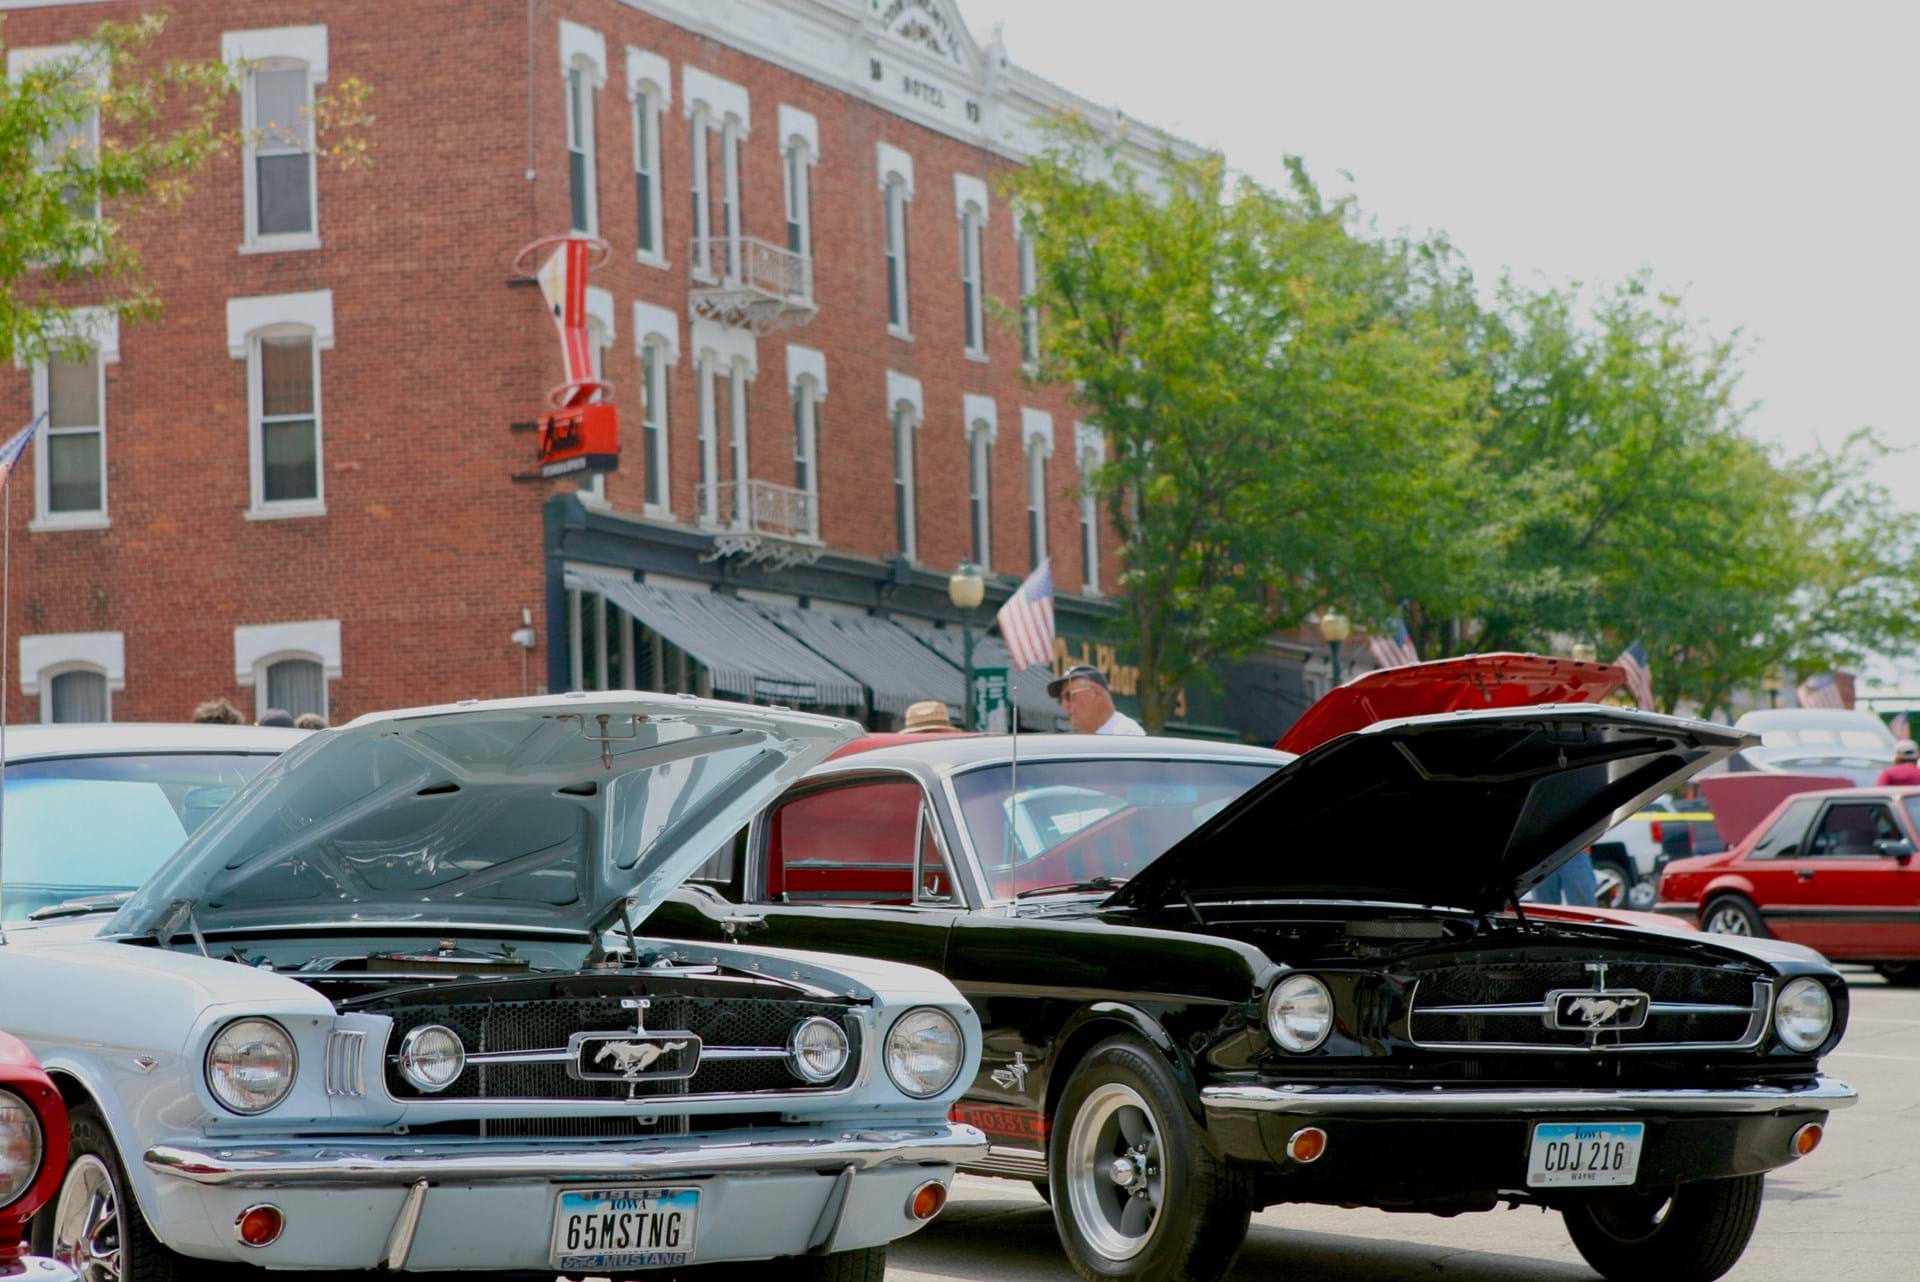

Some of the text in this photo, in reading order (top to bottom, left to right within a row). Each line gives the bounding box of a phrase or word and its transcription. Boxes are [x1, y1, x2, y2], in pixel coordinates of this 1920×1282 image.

[903, 75, 946, 109] HOTEL
[1545, 1141, 1625, 1171] CDJ 216
[1571, 1172, 1597, 1181] WAYNE
[567, 1212, 681, 1250] 65MSTNG
[563, 1252, 687, 1269] Ford MUSTANG
